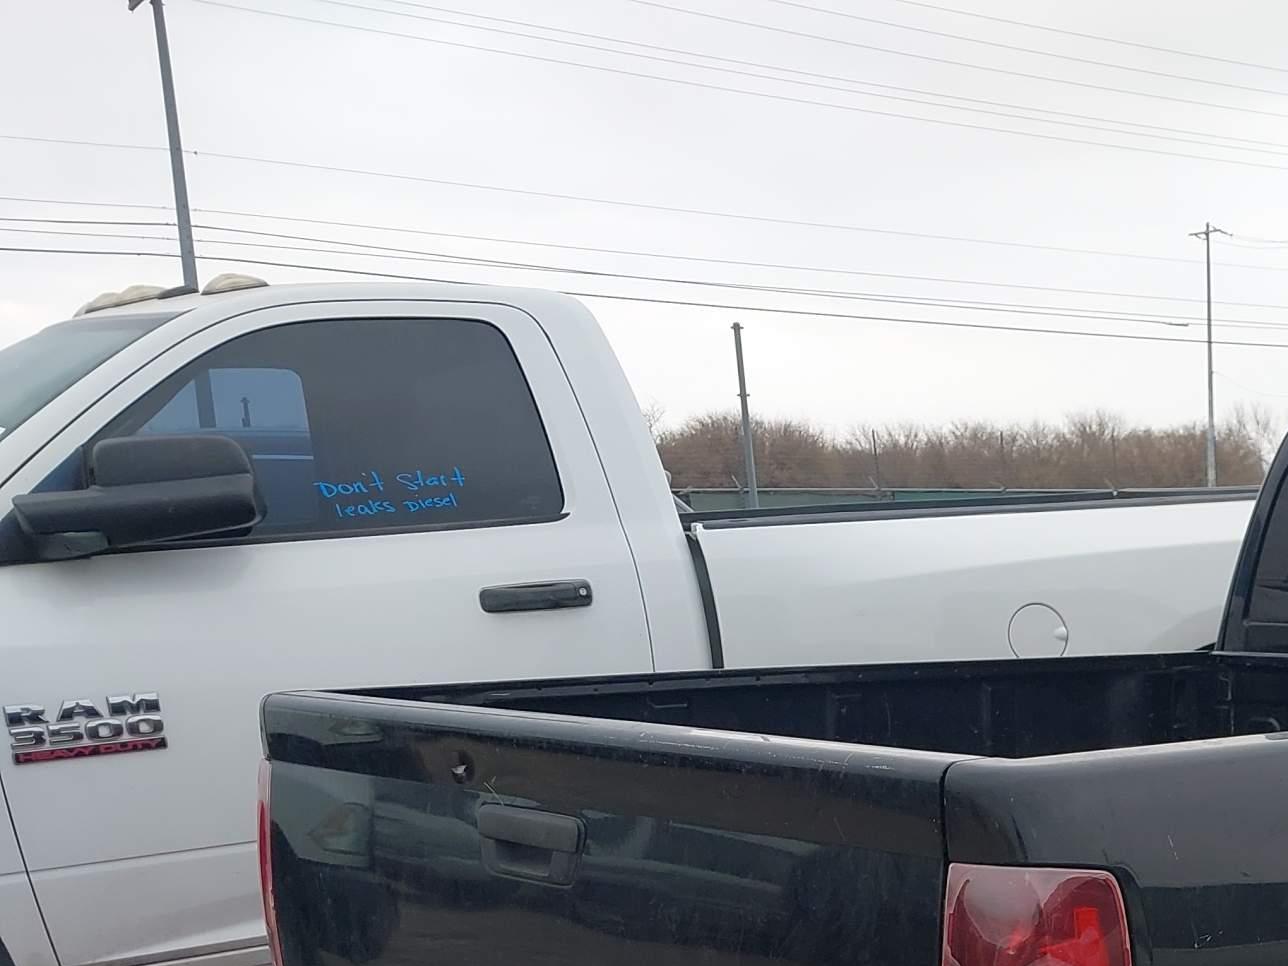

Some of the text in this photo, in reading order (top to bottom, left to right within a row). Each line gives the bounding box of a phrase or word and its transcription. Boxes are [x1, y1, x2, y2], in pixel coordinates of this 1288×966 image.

[313, 467, 465, 498] Don't Start
[335, 493, 458, 519] leaks Diesel
[3, 692, 161, 727] RAM
[8, 714, 164, 750] 3500
[18, 739, 162, 764] HEAVY DUTY
